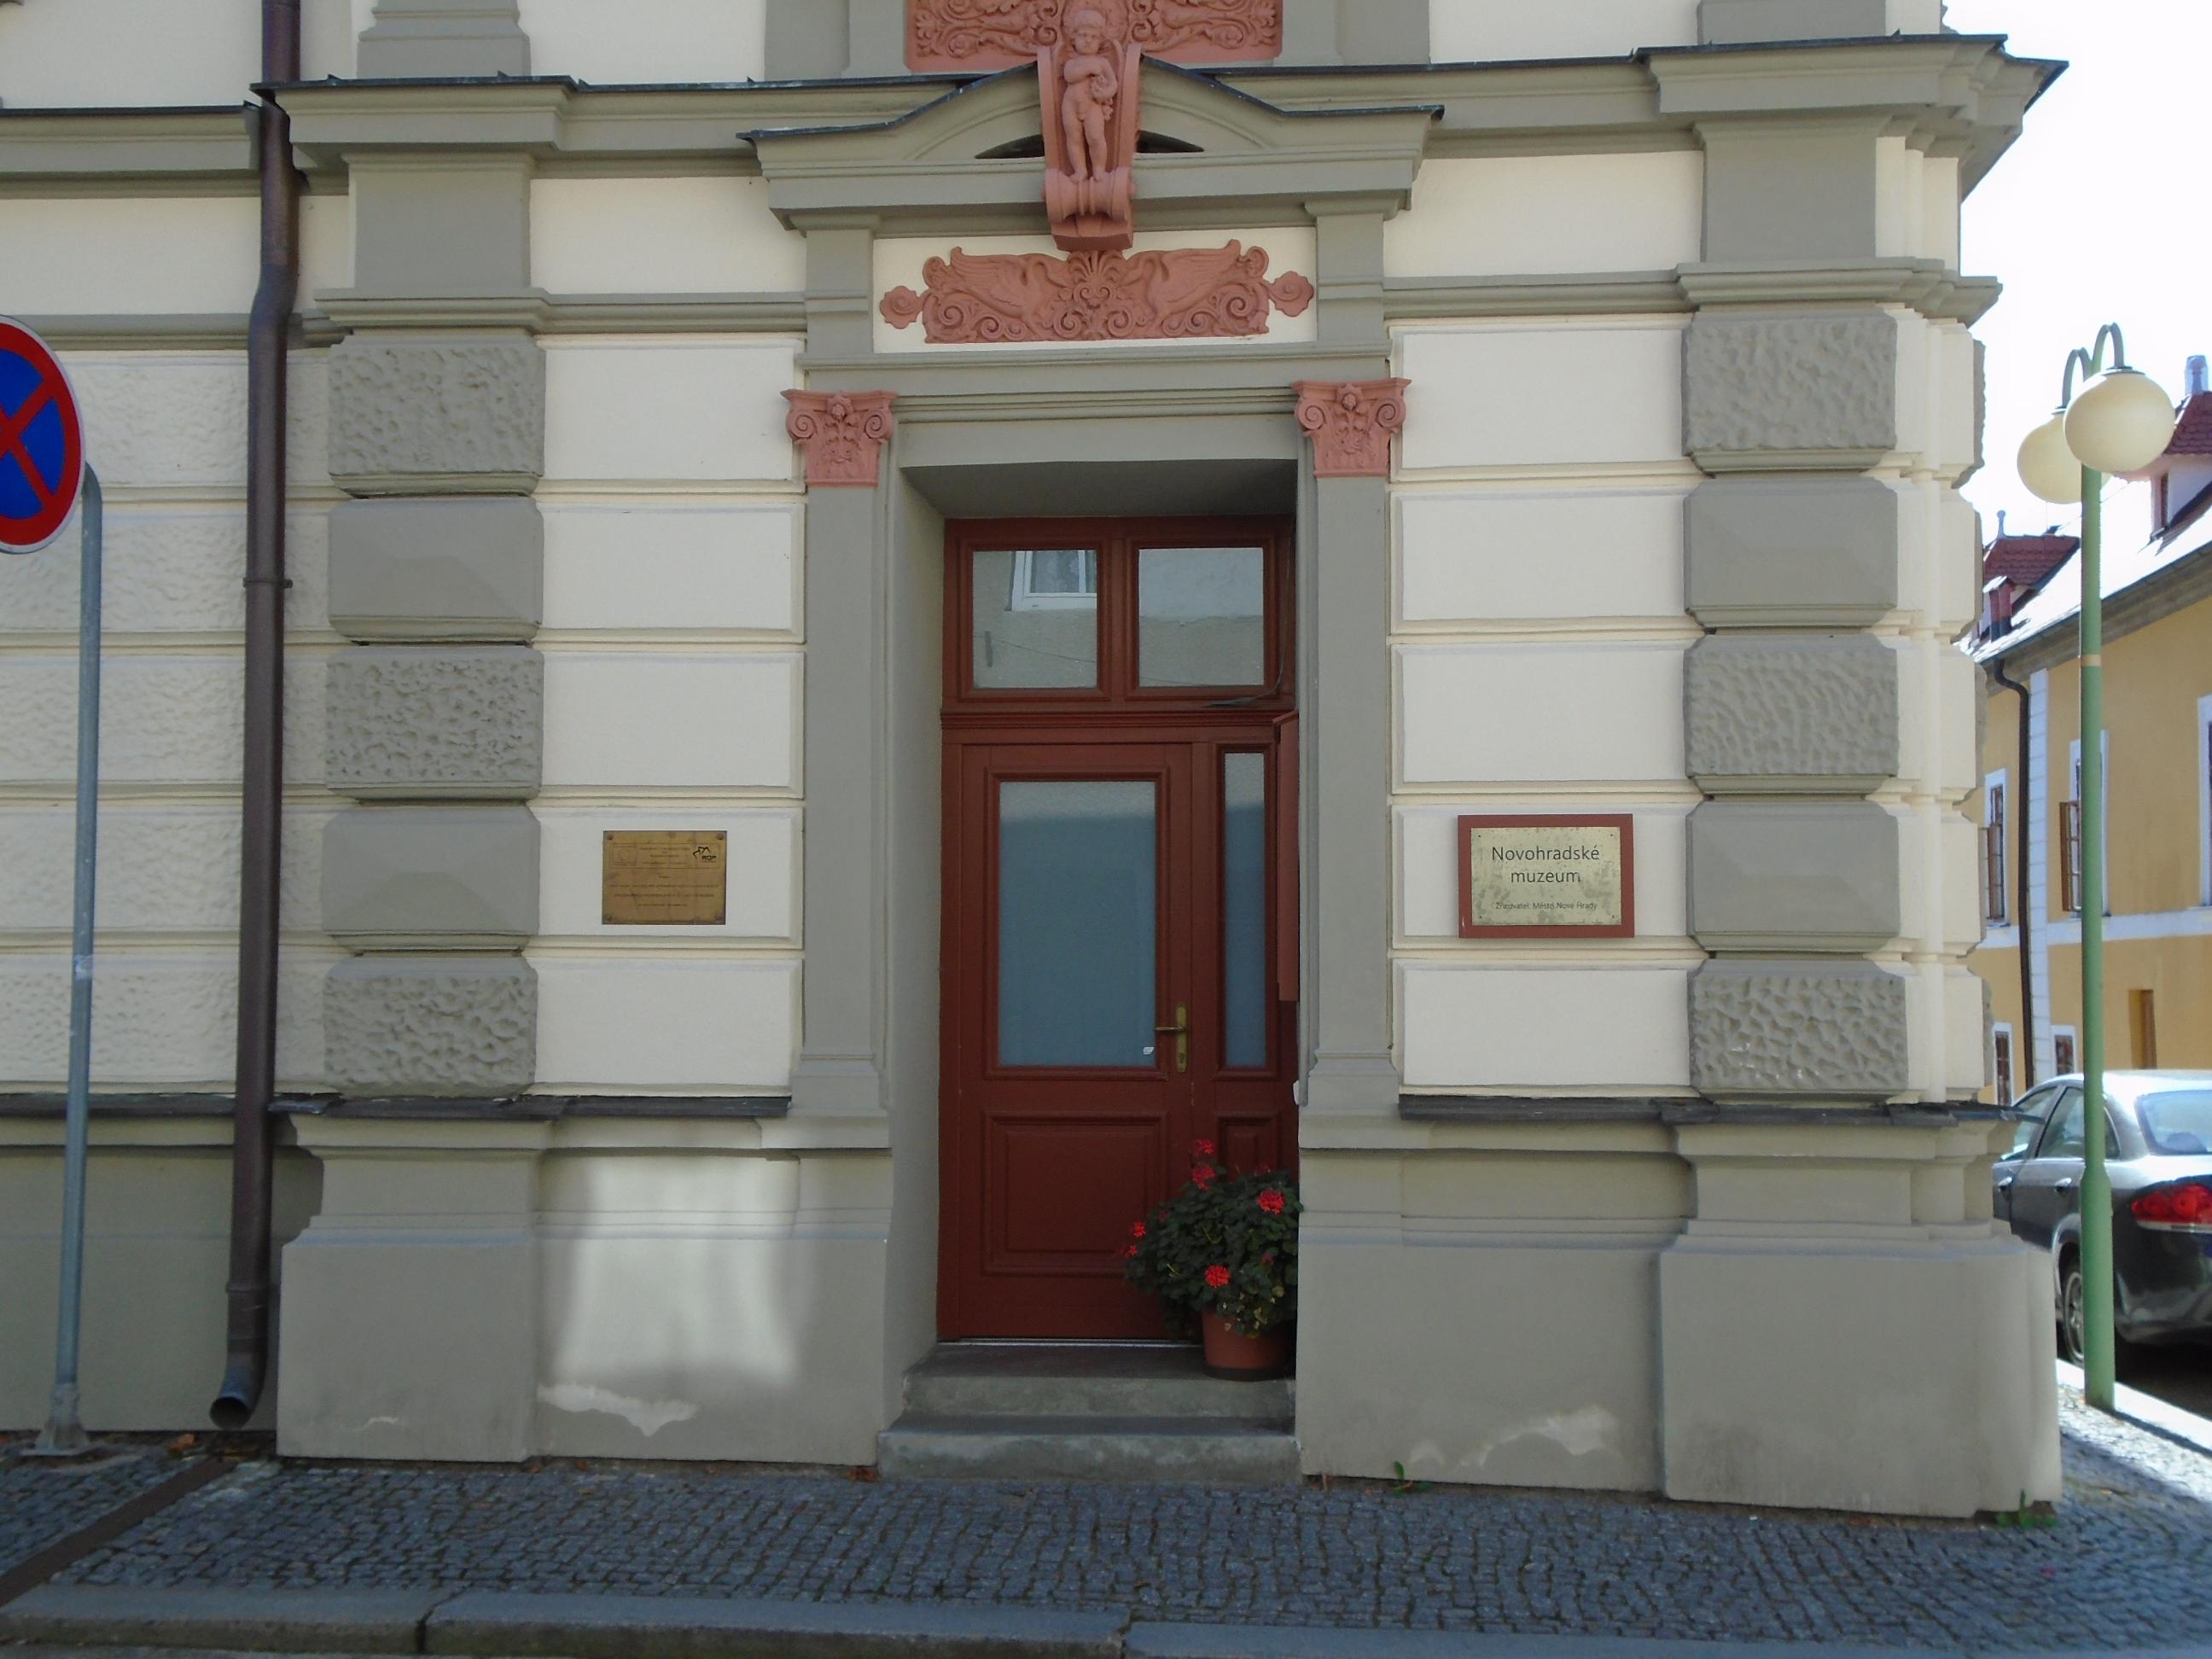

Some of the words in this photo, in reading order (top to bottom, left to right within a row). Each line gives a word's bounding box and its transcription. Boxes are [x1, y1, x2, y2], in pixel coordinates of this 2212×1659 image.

[1492, 845, 1599, 861] Novohradské
[1511, 871, 1581, 883] muzeum
[1576, 901, 1598, 911] Hrady
